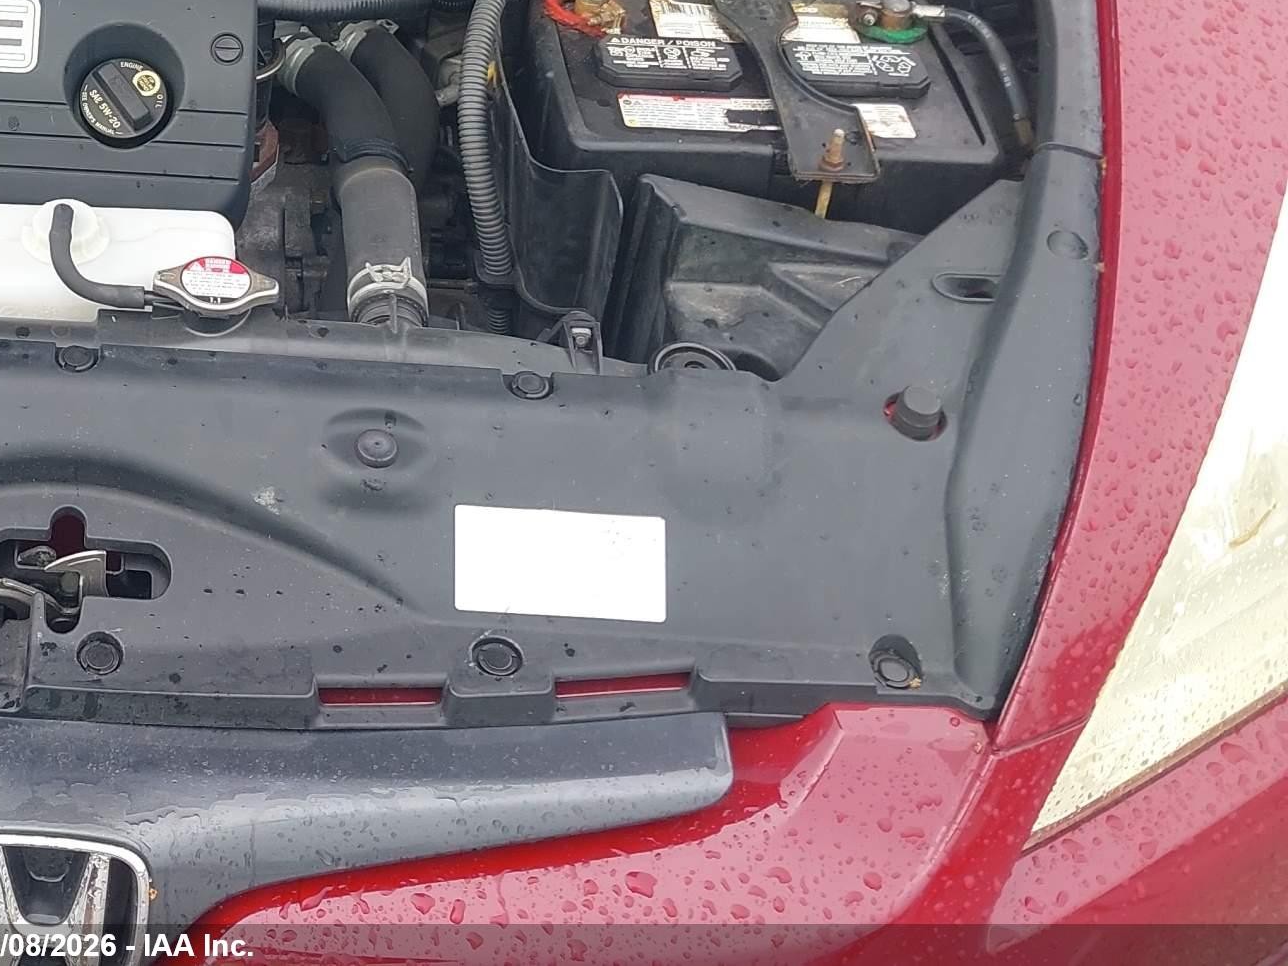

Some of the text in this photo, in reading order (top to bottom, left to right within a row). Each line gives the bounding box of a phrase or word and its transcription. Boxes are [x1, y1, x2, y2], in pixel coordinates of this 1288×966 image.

[621, 37, 665, 46] DANGER
[676, 39, 716, 47] POISON
[120, 61, 164, 108] ENGINE OIL
[89, 89, 121, 128] SAE 5W-20
